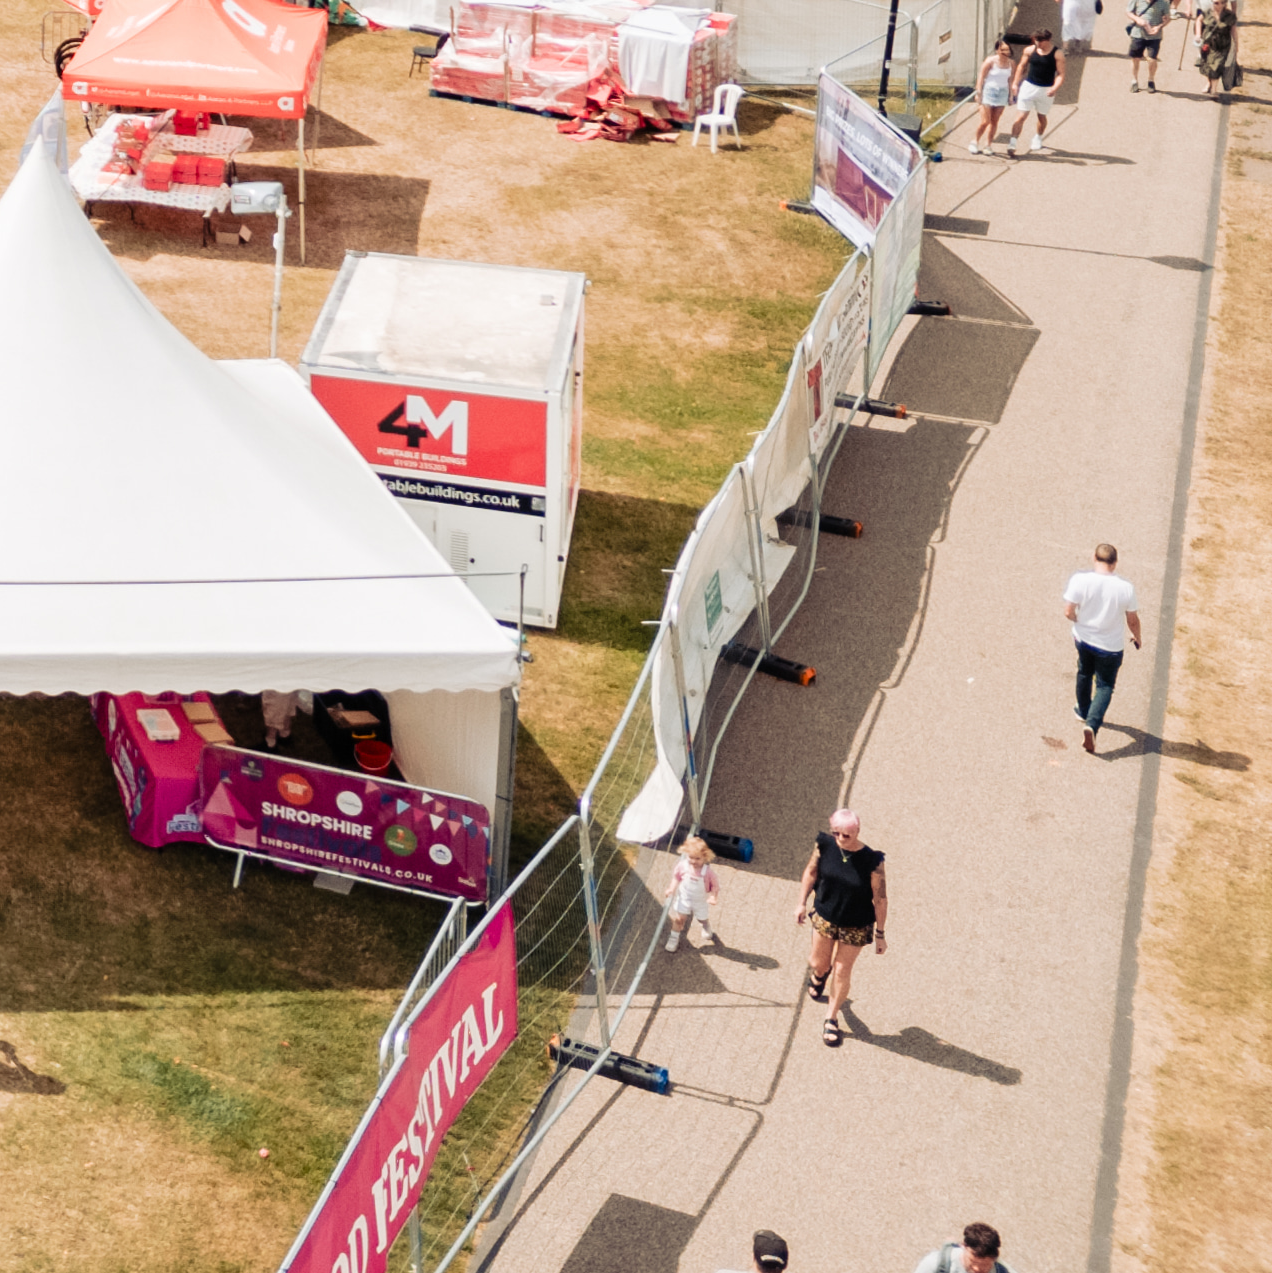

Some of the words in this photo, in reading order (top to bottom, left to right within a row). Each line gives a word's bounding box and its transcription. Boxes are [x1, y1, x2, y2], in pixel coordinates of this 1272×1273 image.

[376, 394, 469, 456] 4M
[377, 447, 420, 460] PORTABLE
[421, 452, 467, 466] BUILDINGS
[261, 801, 374, 841] SHROPSHIRE
[262, 815, 383, 864] Festivals
[261, 835, 434, 884] SHROPSHIREFESTIVALS.CO.UK
[371, 982, 504, 1254] FESTIVAL
